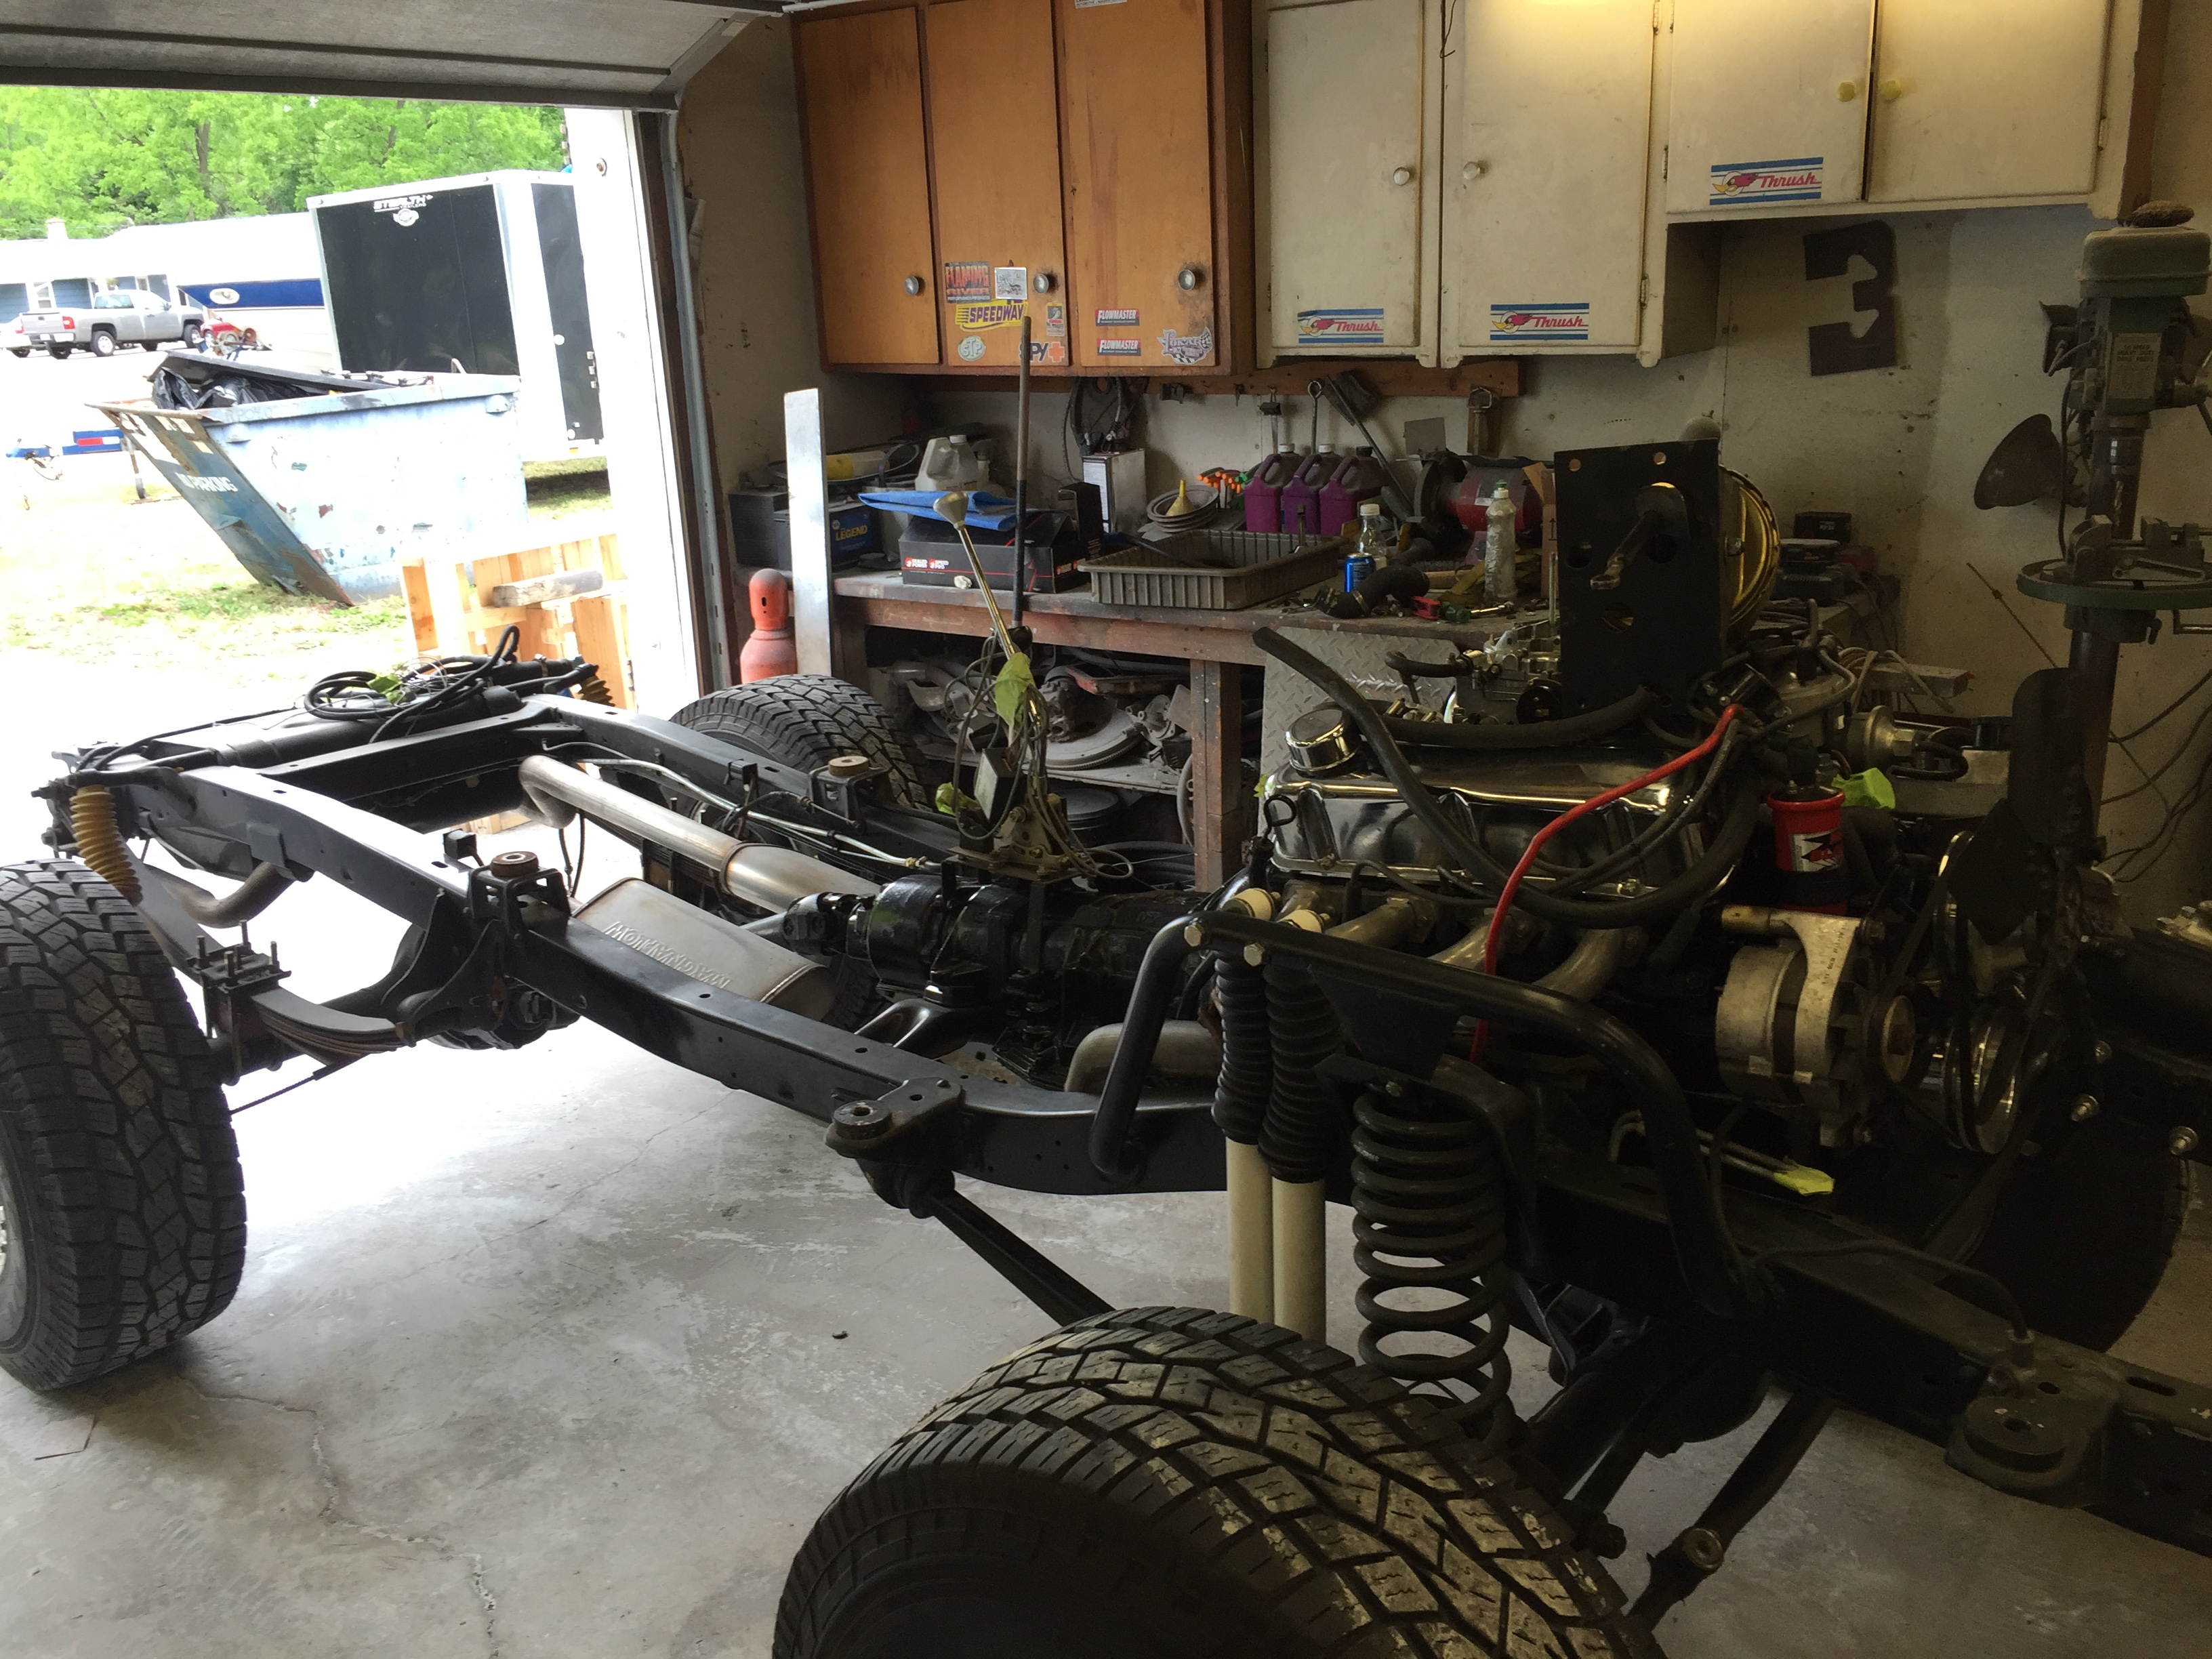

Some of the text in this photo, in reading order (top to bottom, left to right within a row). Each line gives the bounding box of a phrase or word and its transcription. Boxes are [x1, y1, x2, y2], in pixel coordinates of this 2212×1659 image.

[1756, 172, 1822, 188] Thrush
[945, 265, 989, 287] FLAMING
[1803, 220, 1897, 376] 3
[970, 304, 1024, 323] SPEEDWAY
[1097, 310, 1136, 323] FLOWMASTER
[1532, 316, 1589, 327] Thrush
[1334, 321, 1384, 331] Thrush
[963, 339, 983, 356] STP
[1019, 342, 1048, 361] PY
[1099, 340, 1139, 352] FLOWMASTER
[186, 475, 239, 492] PARKING
[836, 525, 867, 541] LEGEND
